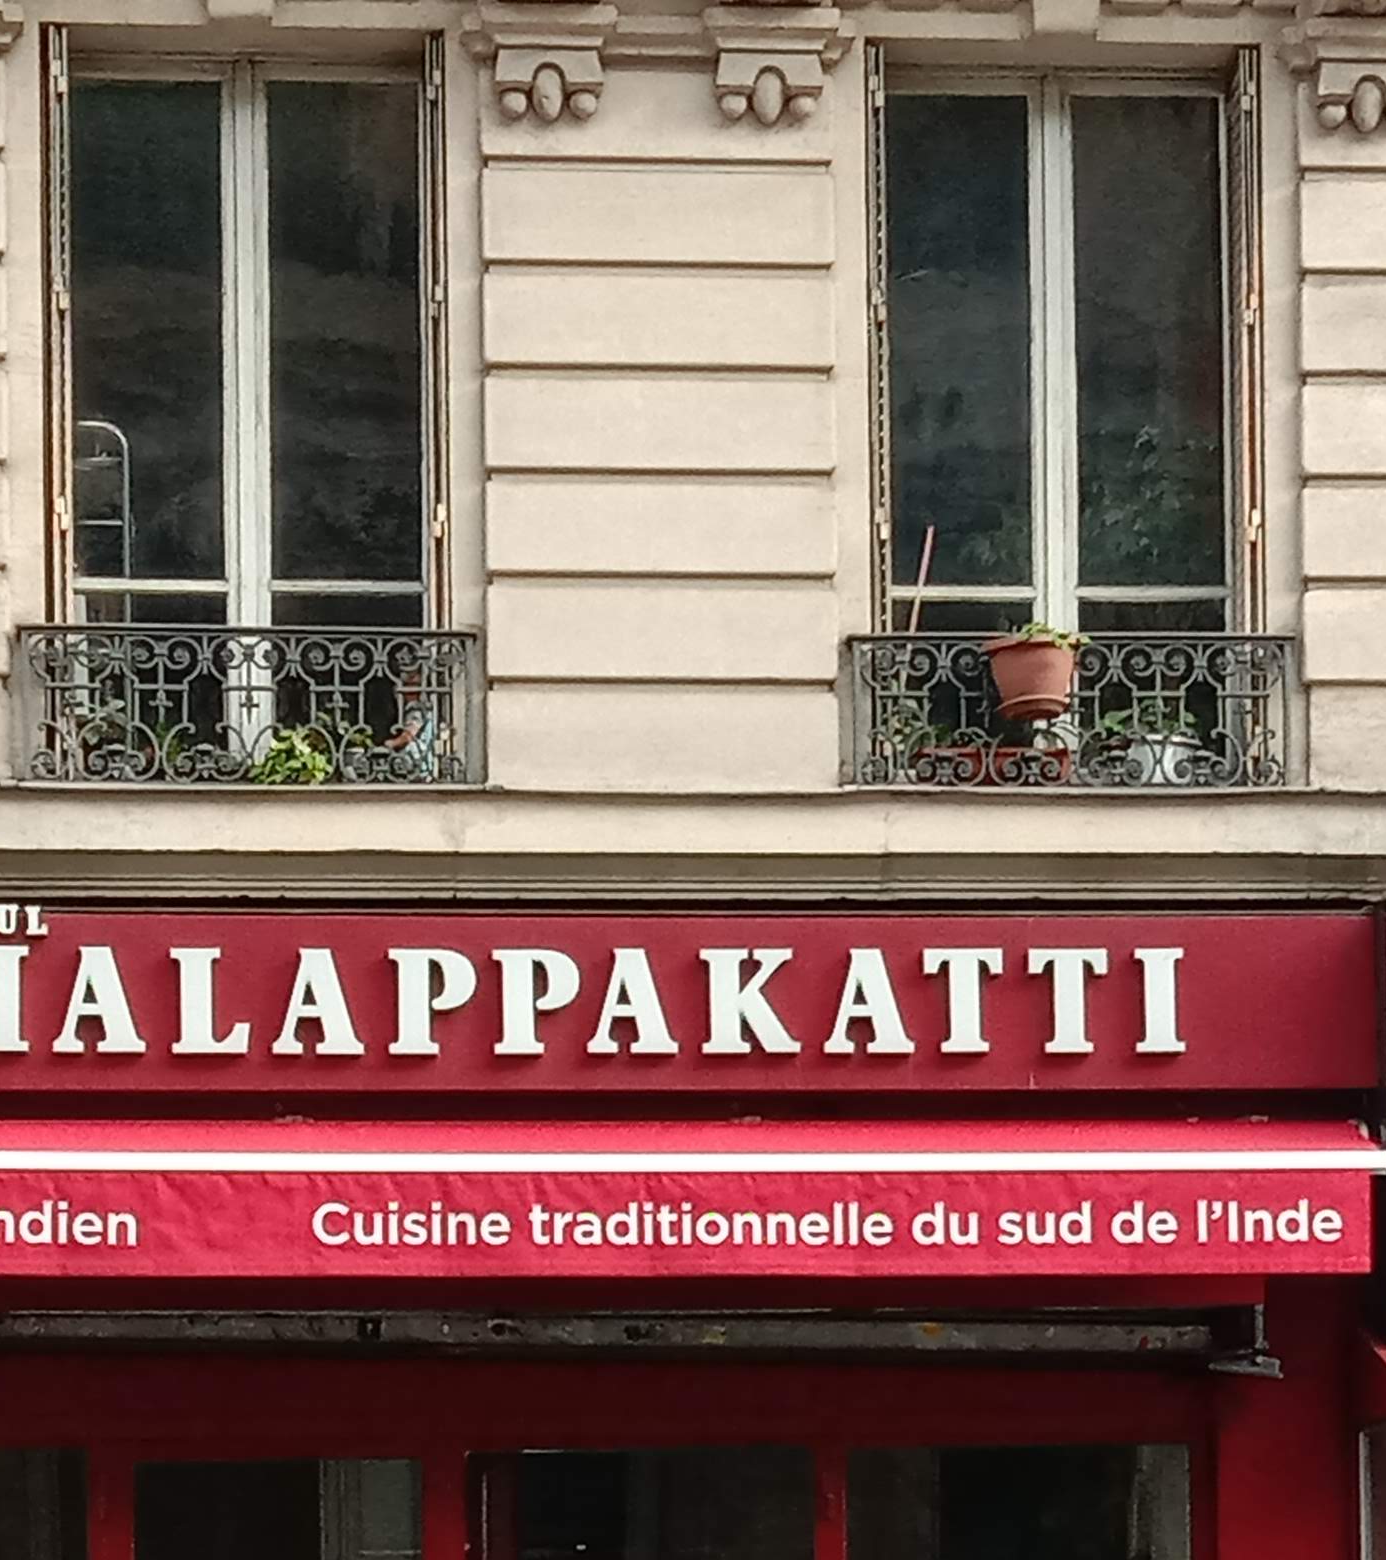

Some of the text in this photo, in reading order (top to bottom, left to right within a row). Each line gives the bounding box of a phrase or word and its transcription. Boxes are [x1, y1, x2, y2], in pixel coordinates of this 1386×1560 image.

[312, 1201, 511, 1245] Cuisine
[528, 1201, 893, 1246] traditionnelle
[912, 1201, 979, 1245] du
[997, 1200, 1092, 1245] sud
[1111, 1200, 1178, 1244] de
